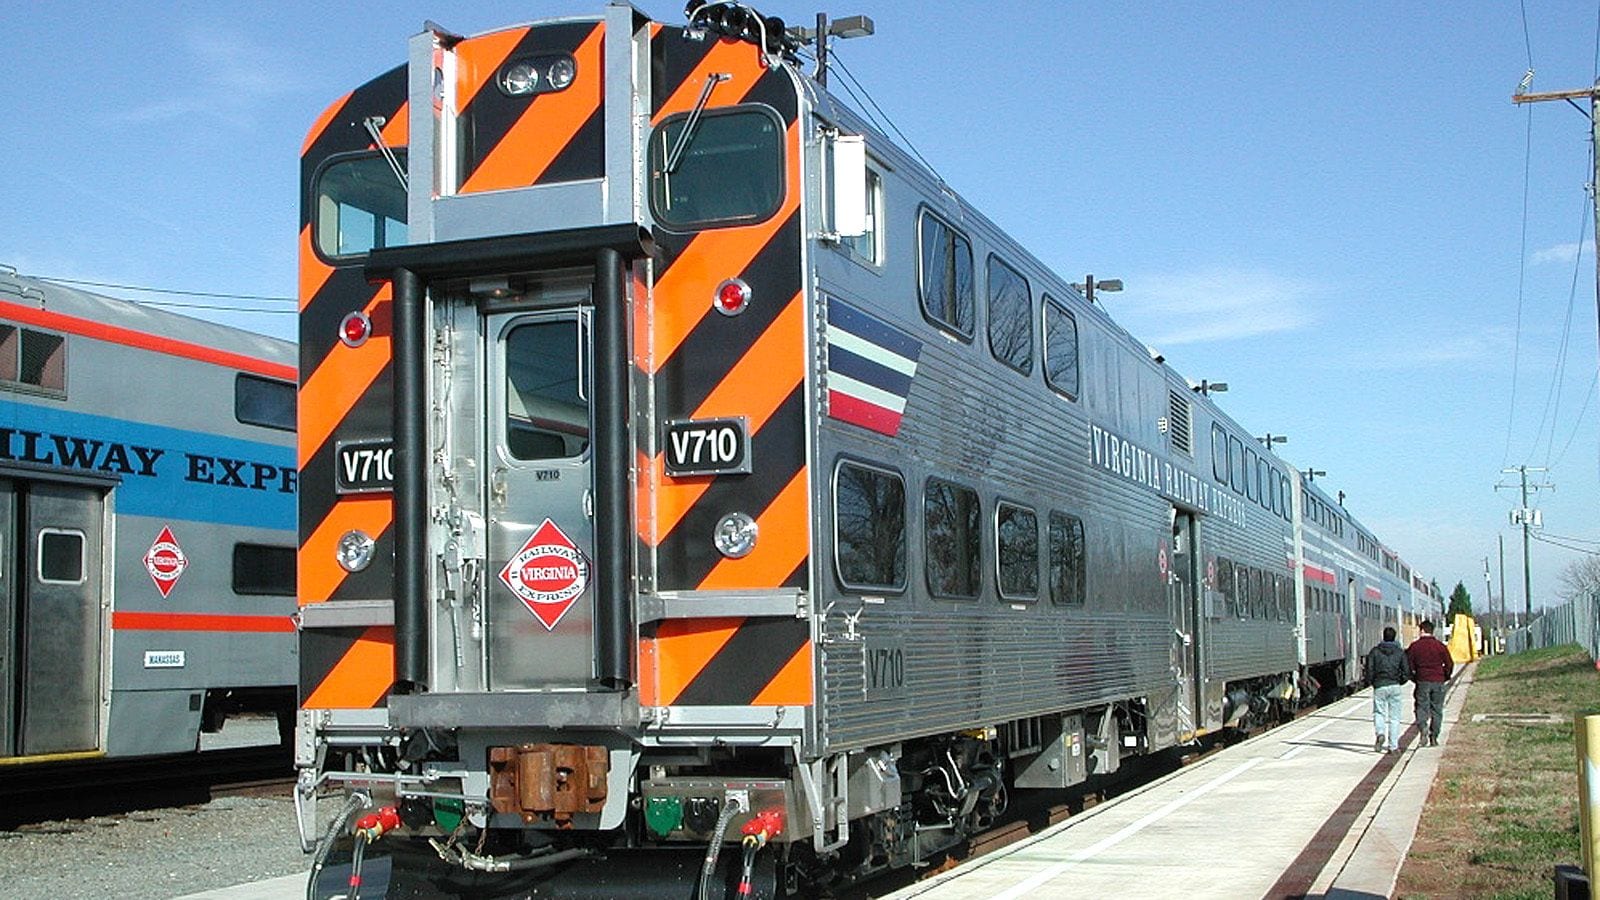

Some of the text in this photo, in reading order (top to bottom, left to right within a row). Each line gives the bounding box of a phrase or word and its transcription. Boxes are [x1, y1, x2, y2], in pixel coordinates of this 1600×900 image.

[671, 427, 737, 464] V710
[1092, 425, 1160, 490] VIRGINIA
[535, 469, 560, 480] V710
[519, 546, 582, 565] RAILWAY
[521, 566, 577, 581] VIRGINIA
[519, 583, 580, 601] EXPRESS
[869, 648, 903, 688] V710
